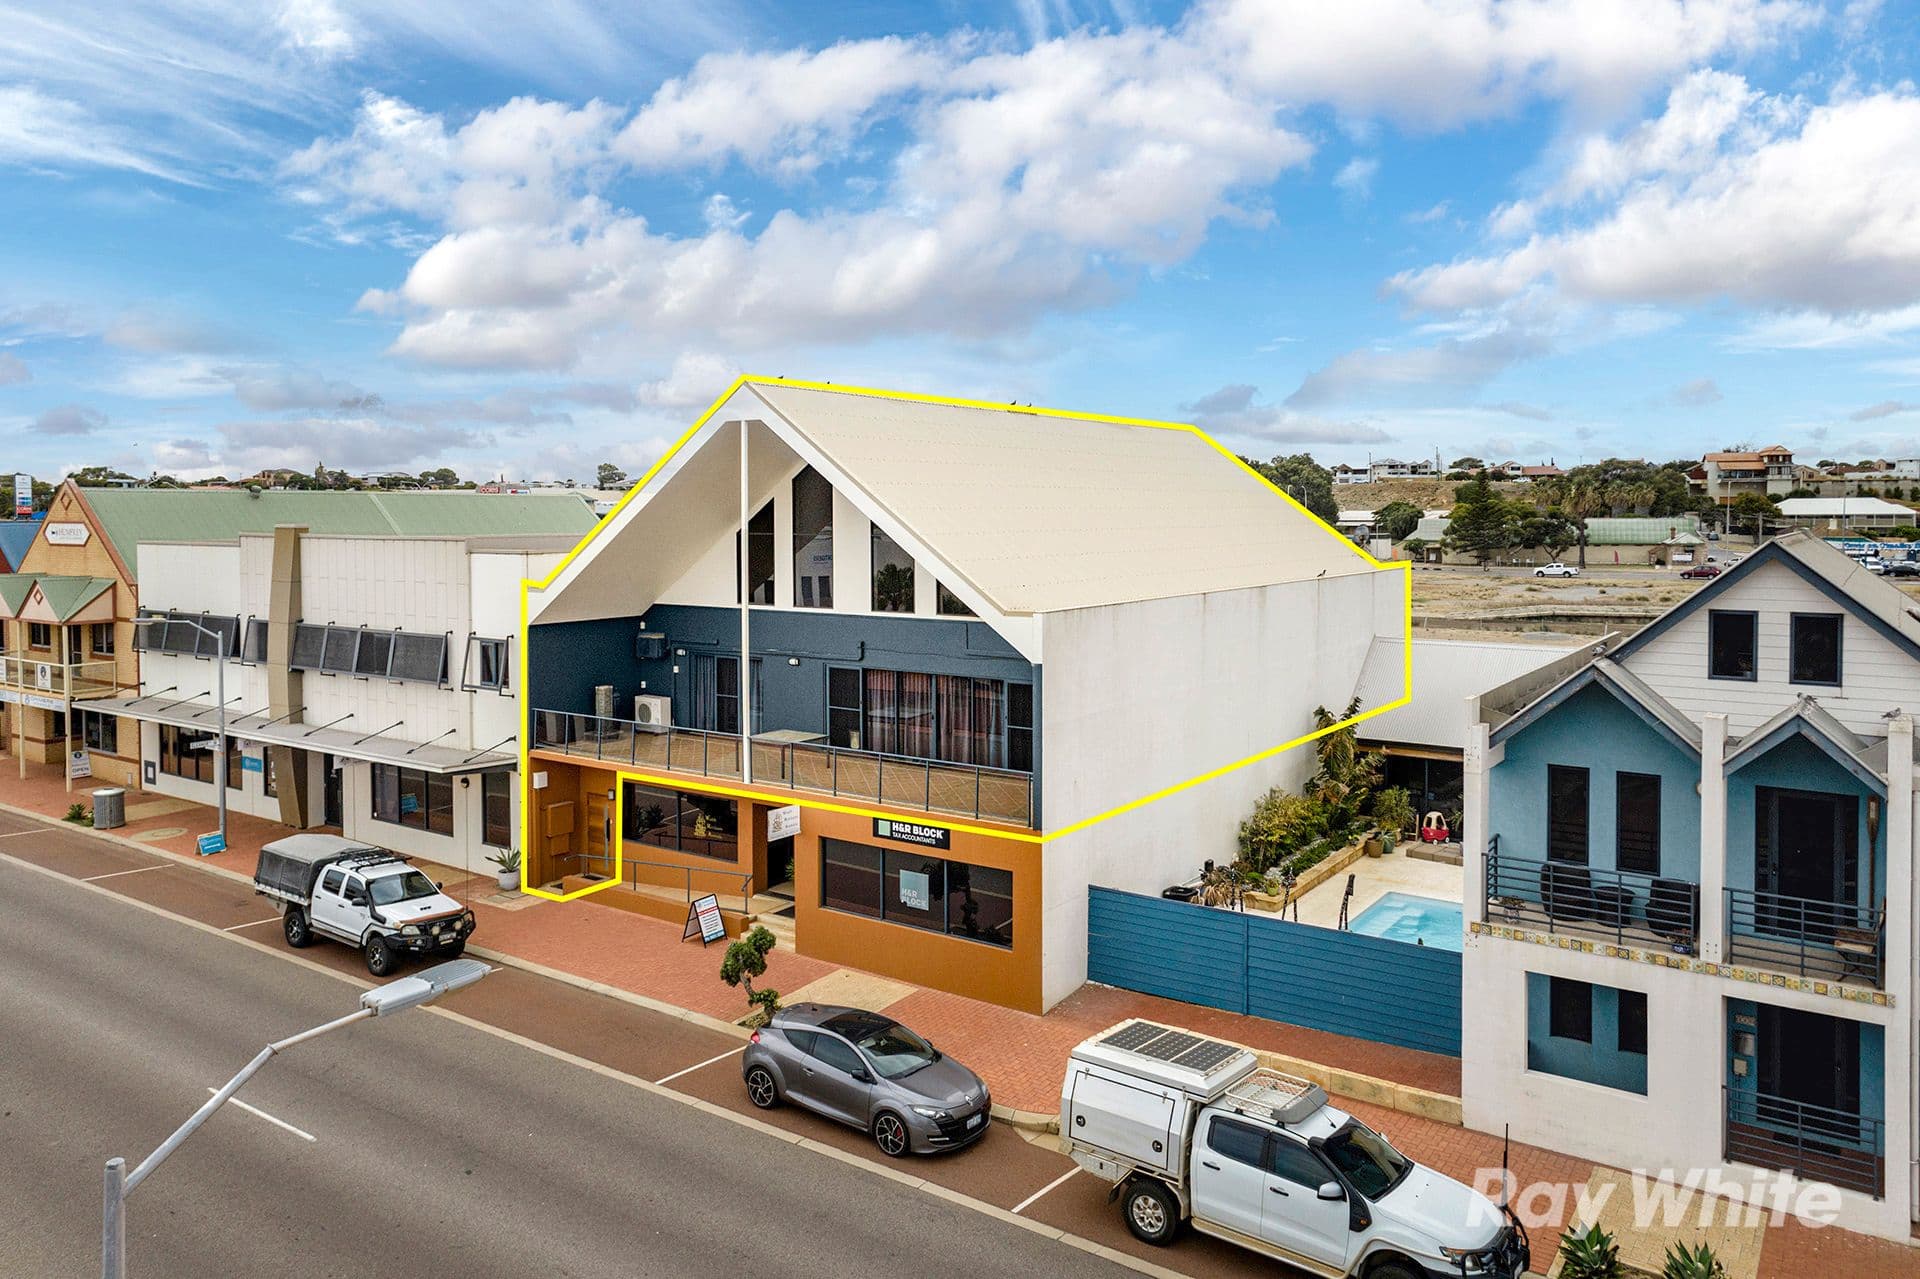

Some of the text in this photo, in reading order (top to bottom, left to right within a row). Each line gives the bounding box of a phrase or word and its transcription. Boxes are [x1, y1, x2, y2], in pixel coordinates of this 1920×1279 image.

[892, 822, 944, 839] H&R BLOCK
[902, 834, 936, 844] ACCOUNTANTS
